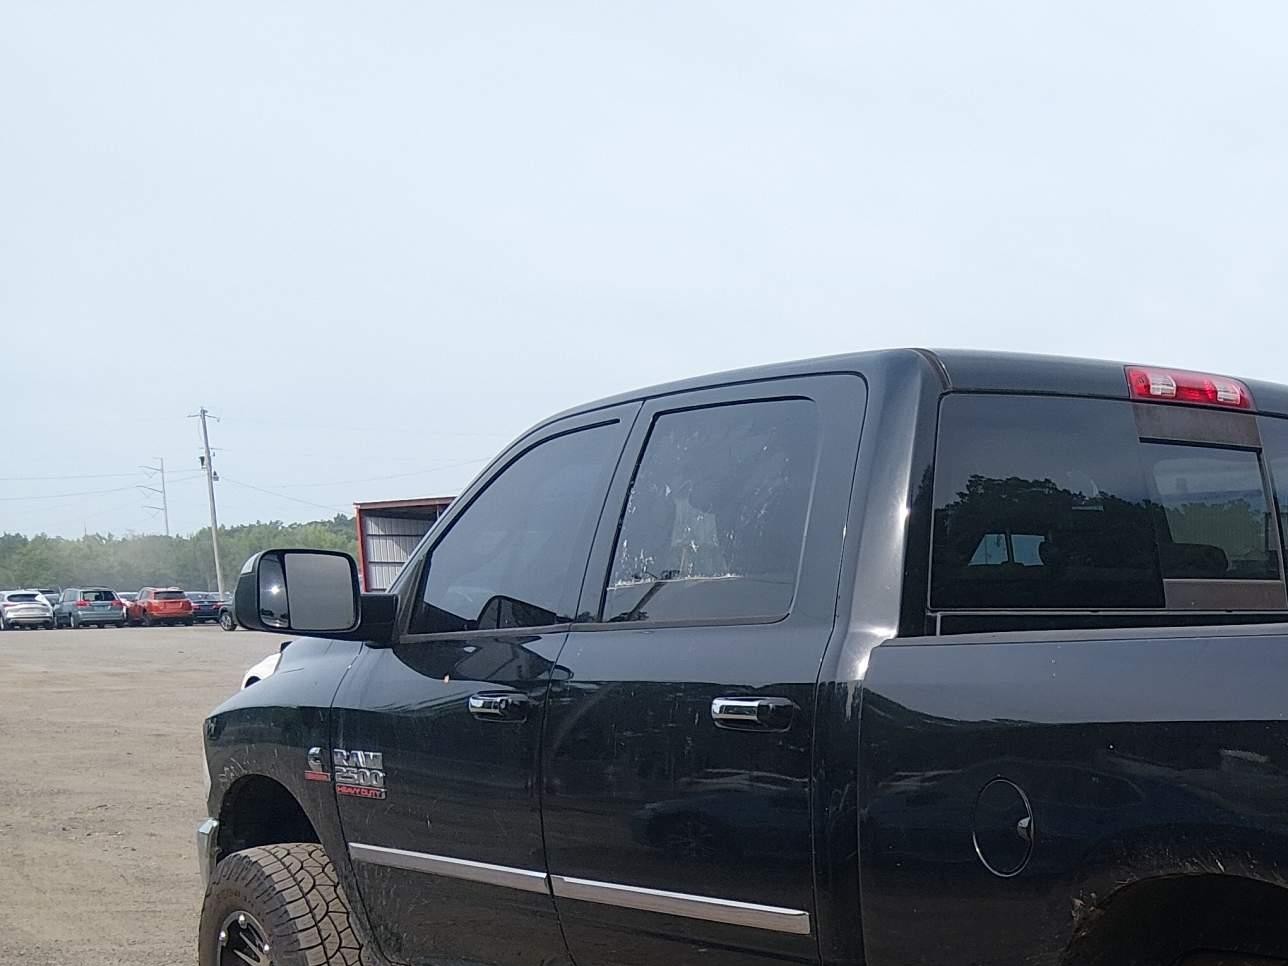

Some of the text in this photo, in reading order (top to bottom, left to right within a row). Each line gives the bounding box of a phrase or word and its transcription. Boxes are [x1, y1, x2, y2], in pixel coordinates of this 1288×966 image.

[333, 749, 383, 769] RAM
[334, 766, 385, 787] 2500
[337, 785, 382, 798] HEAVY DUTY
